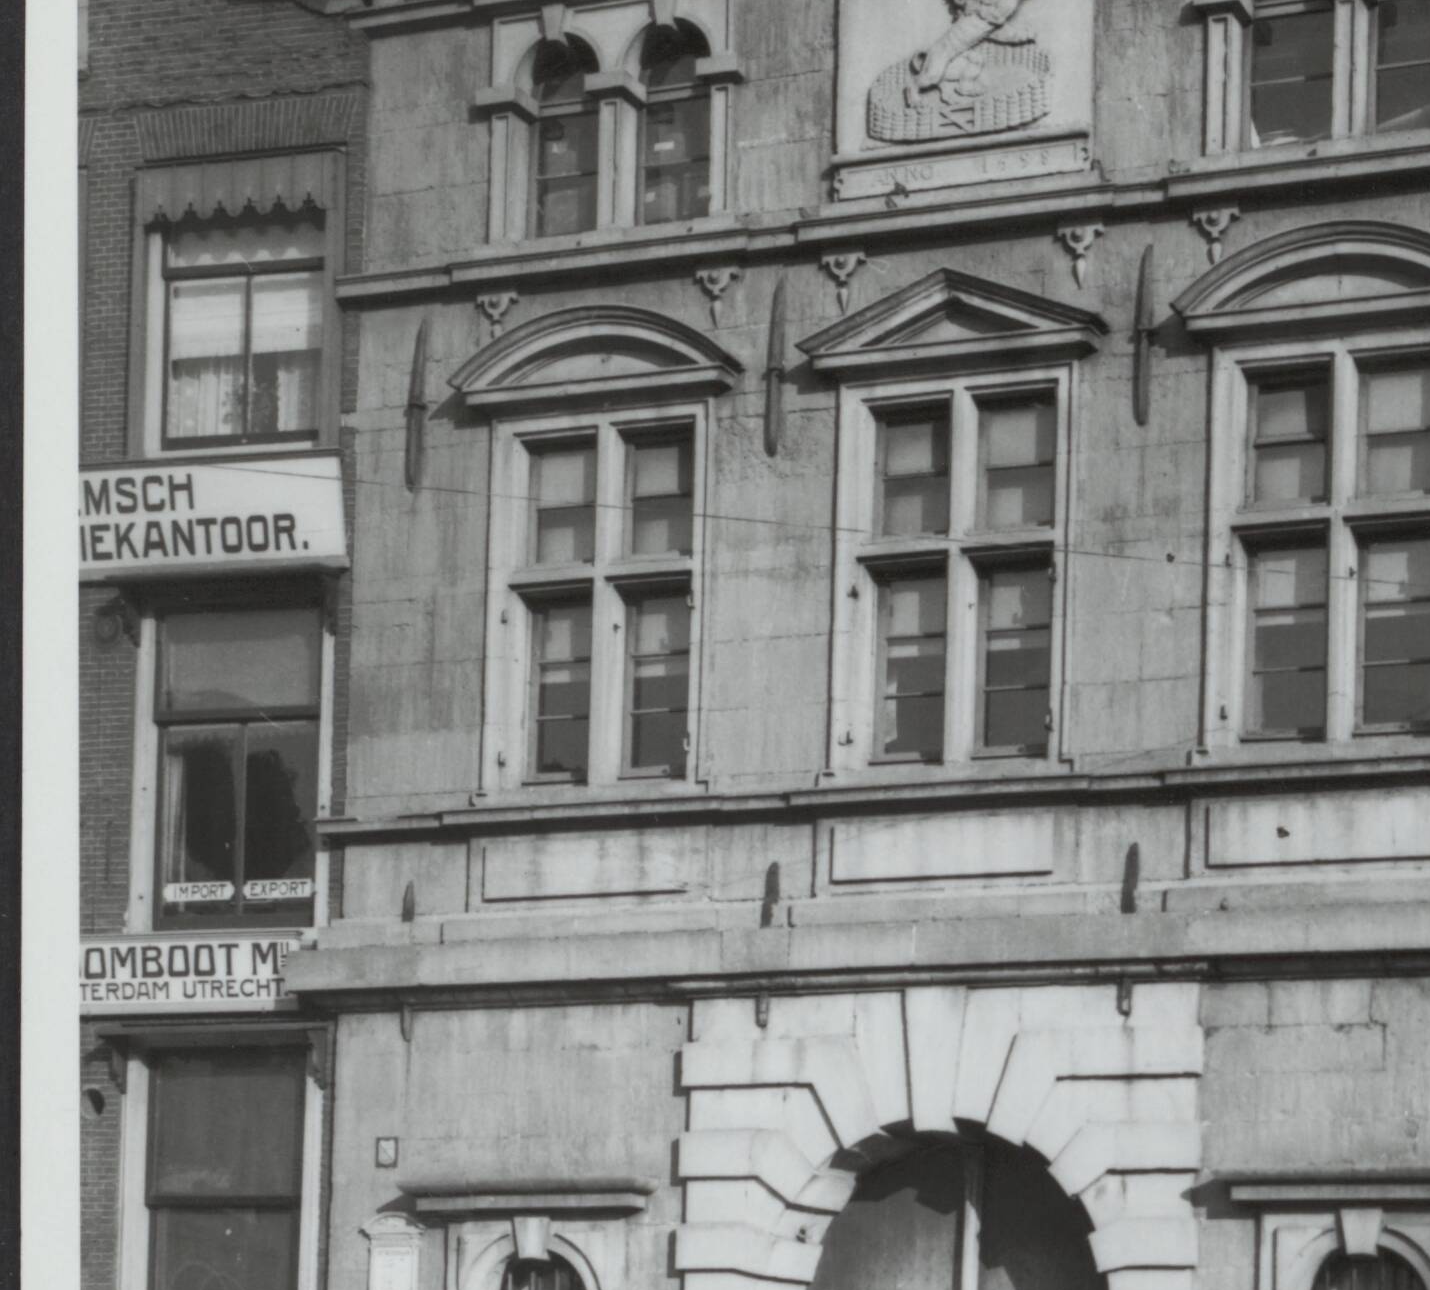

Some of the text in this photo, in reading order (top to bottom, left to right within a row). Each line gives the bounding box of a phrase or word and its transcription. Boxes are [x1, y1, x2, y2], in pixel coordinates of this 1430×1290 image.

[79, 473, 195, 517] MSCH
[173, 882, 228, 899] IMPORT
[249, 879, 308, 897] EXPORT
[79, 943, 239, 979] OMBOOT
